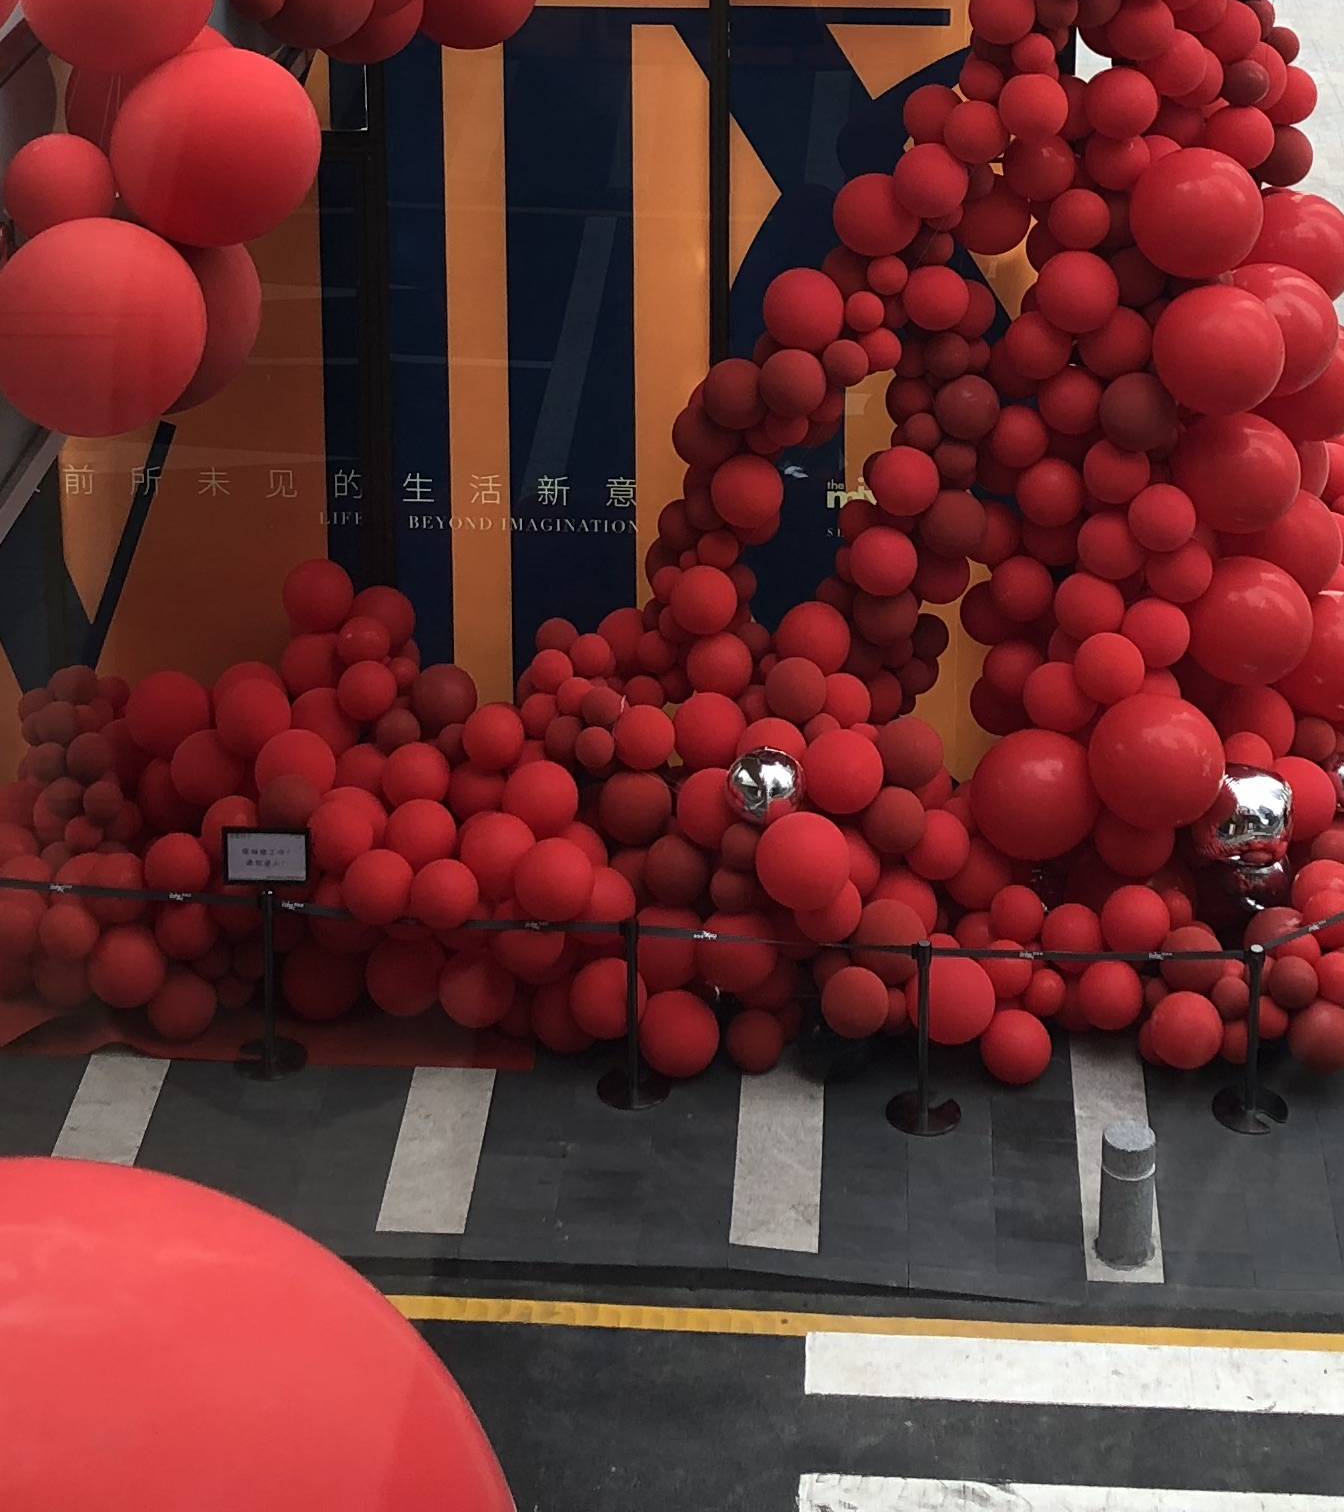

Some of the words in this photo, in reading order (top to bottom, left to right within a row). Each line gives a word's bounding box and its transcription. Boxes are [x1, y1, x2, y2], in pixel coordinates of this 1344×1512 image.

[63, 463, 638, 507] 前所未见的生活新意
[408, 514, 493, 531] BEYOND
[500, 517, 641, 534] IMAGINATION
